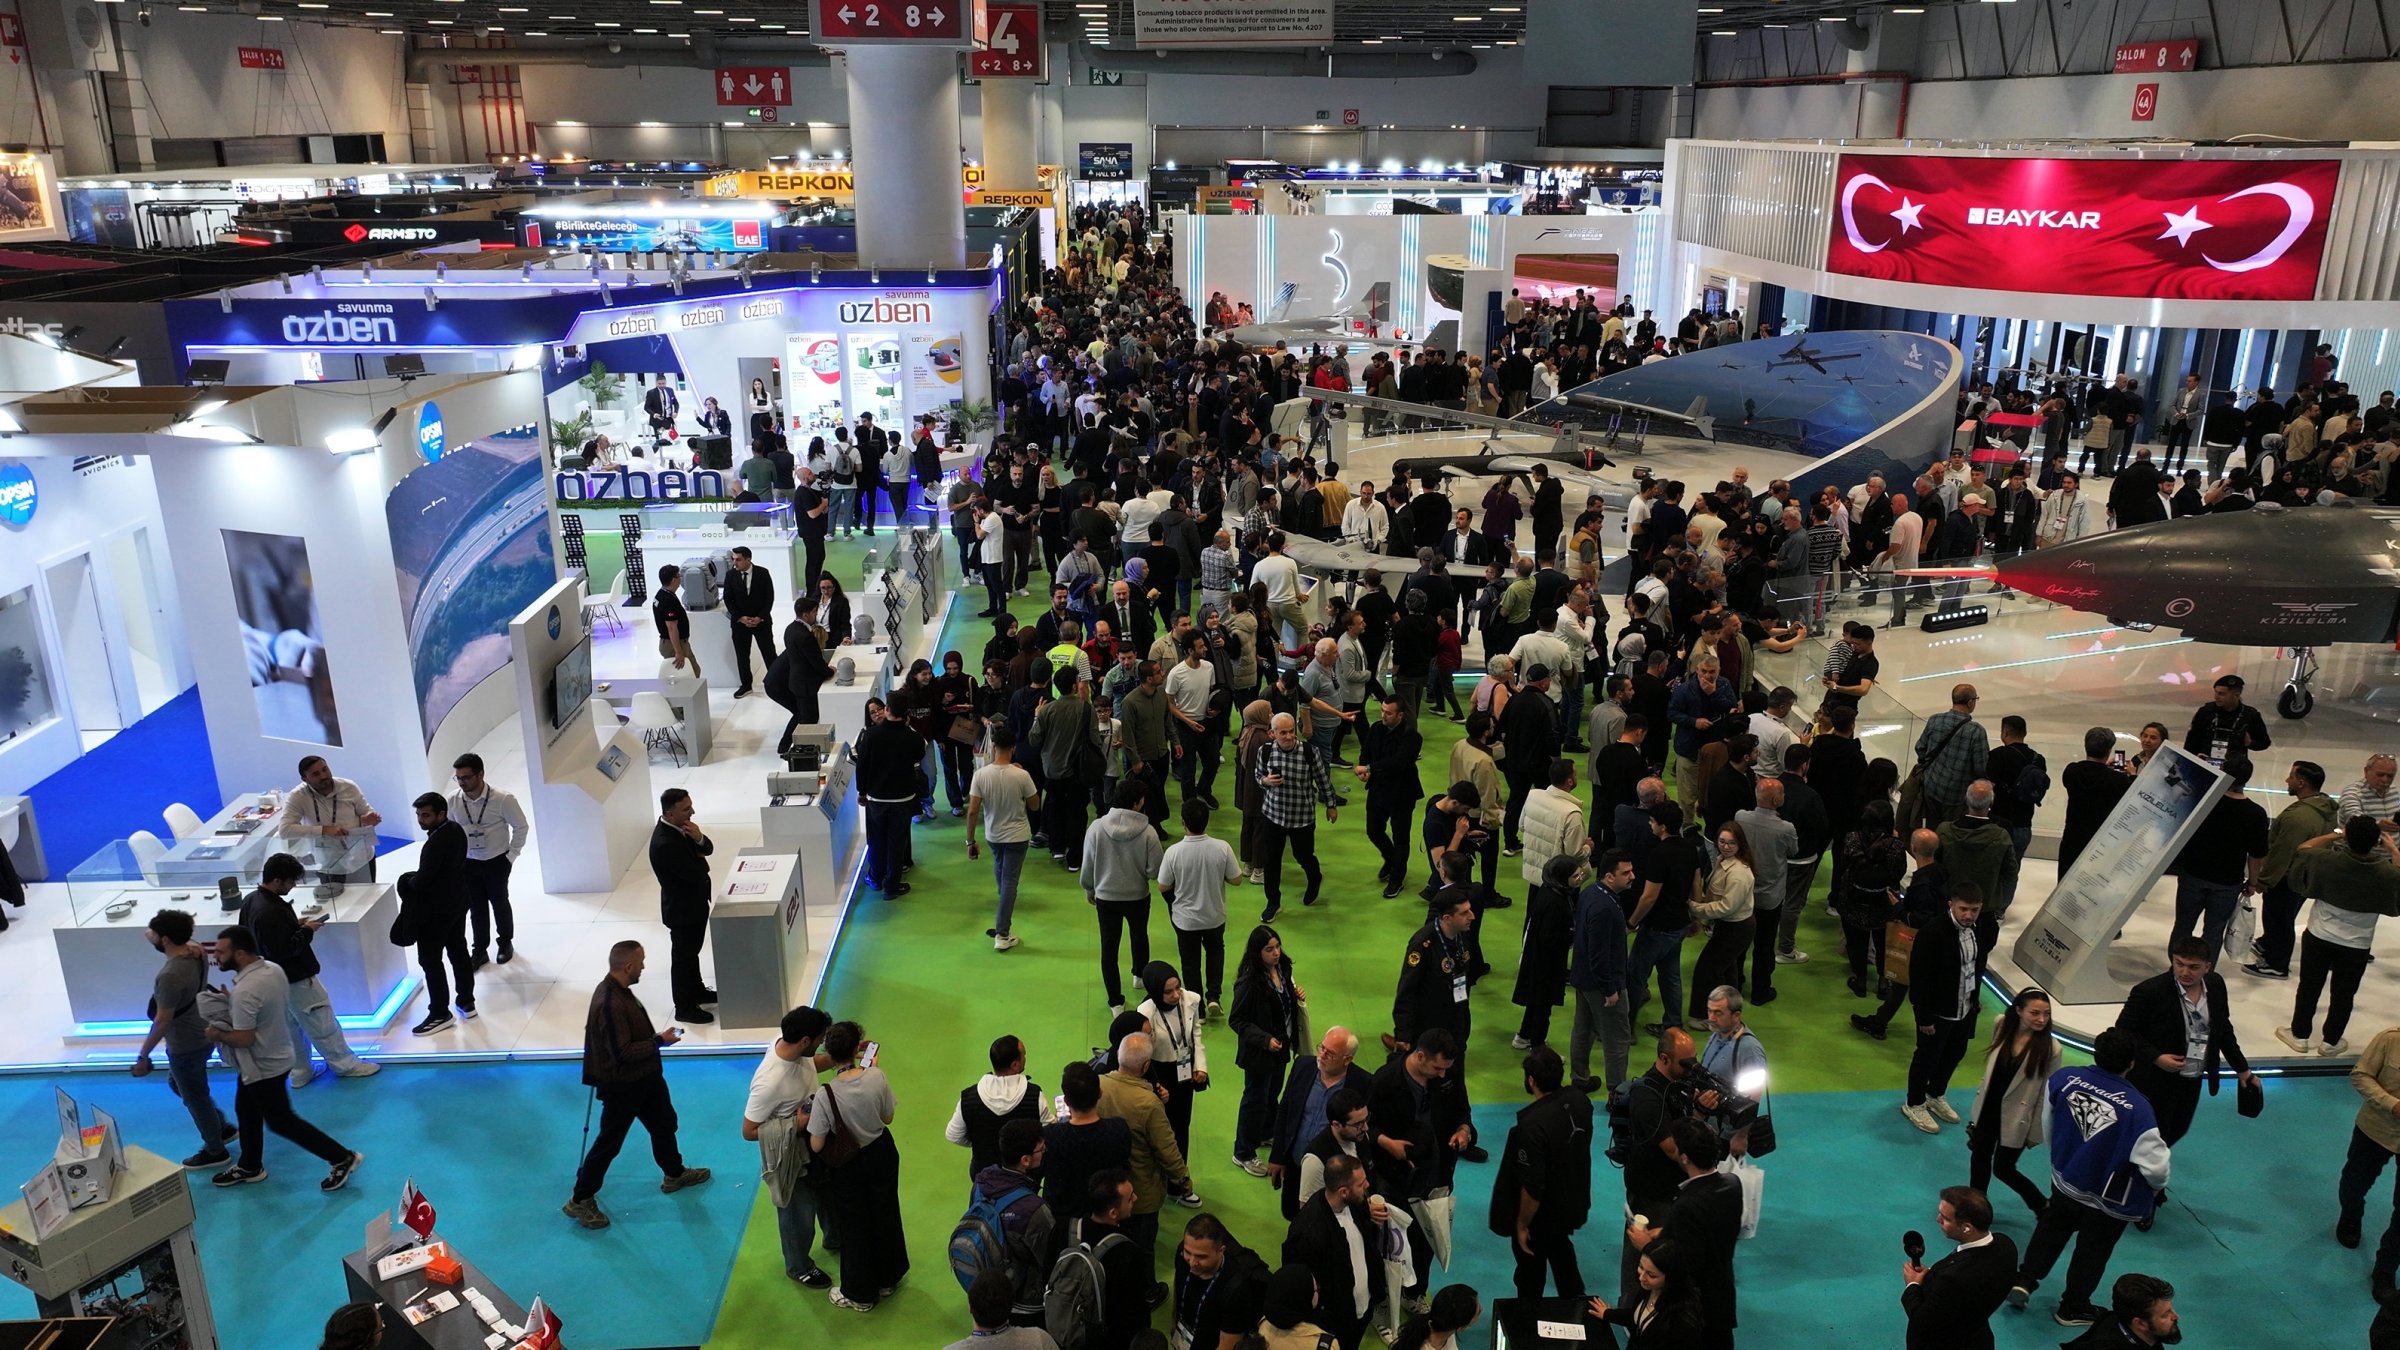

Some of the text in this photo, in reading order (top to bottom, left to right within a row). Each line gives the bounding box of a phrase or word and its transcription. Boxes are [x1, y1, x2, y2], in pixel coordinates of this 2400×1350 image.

[865, 4, 921, 28] 2 8
[1204, 8, 1234, 16] products
[1255, 8, 1288, 16] permitted
[1155, 17, 1204, 25] Administrative
[1227, 16, 1248, 24] issued
[1249, 16, 1259, 24] for
[991, 12, 1020, 55] 4
[1199, 25, 1237, 33] consuming,
[1238, 25, 1267, 33] pursuant
[241, 50, 260, 60] SALON
[2116, 47, 2167, 67] SALON 8
[994, 60, 1020, 71] 2 8
[2138, 96, 2149, 109] 4A
[758, 175, 854, 190] REPKON
[983, 195, 1044, 205] REPKON
[1986, 208, 2101, 230] BAYKAR
[368, 228, 437, 240] ARMSTO
[736, 235, 759, 245] EAE
[885, 291, 930, 299] savunma
[337, 303, 394, 314] savunma
[83, 459, 120, 477] AVIONICS
[2260, 617, 2347, 625] KIZILELMA
[2066, 1075, 2134, 1111] paradise
